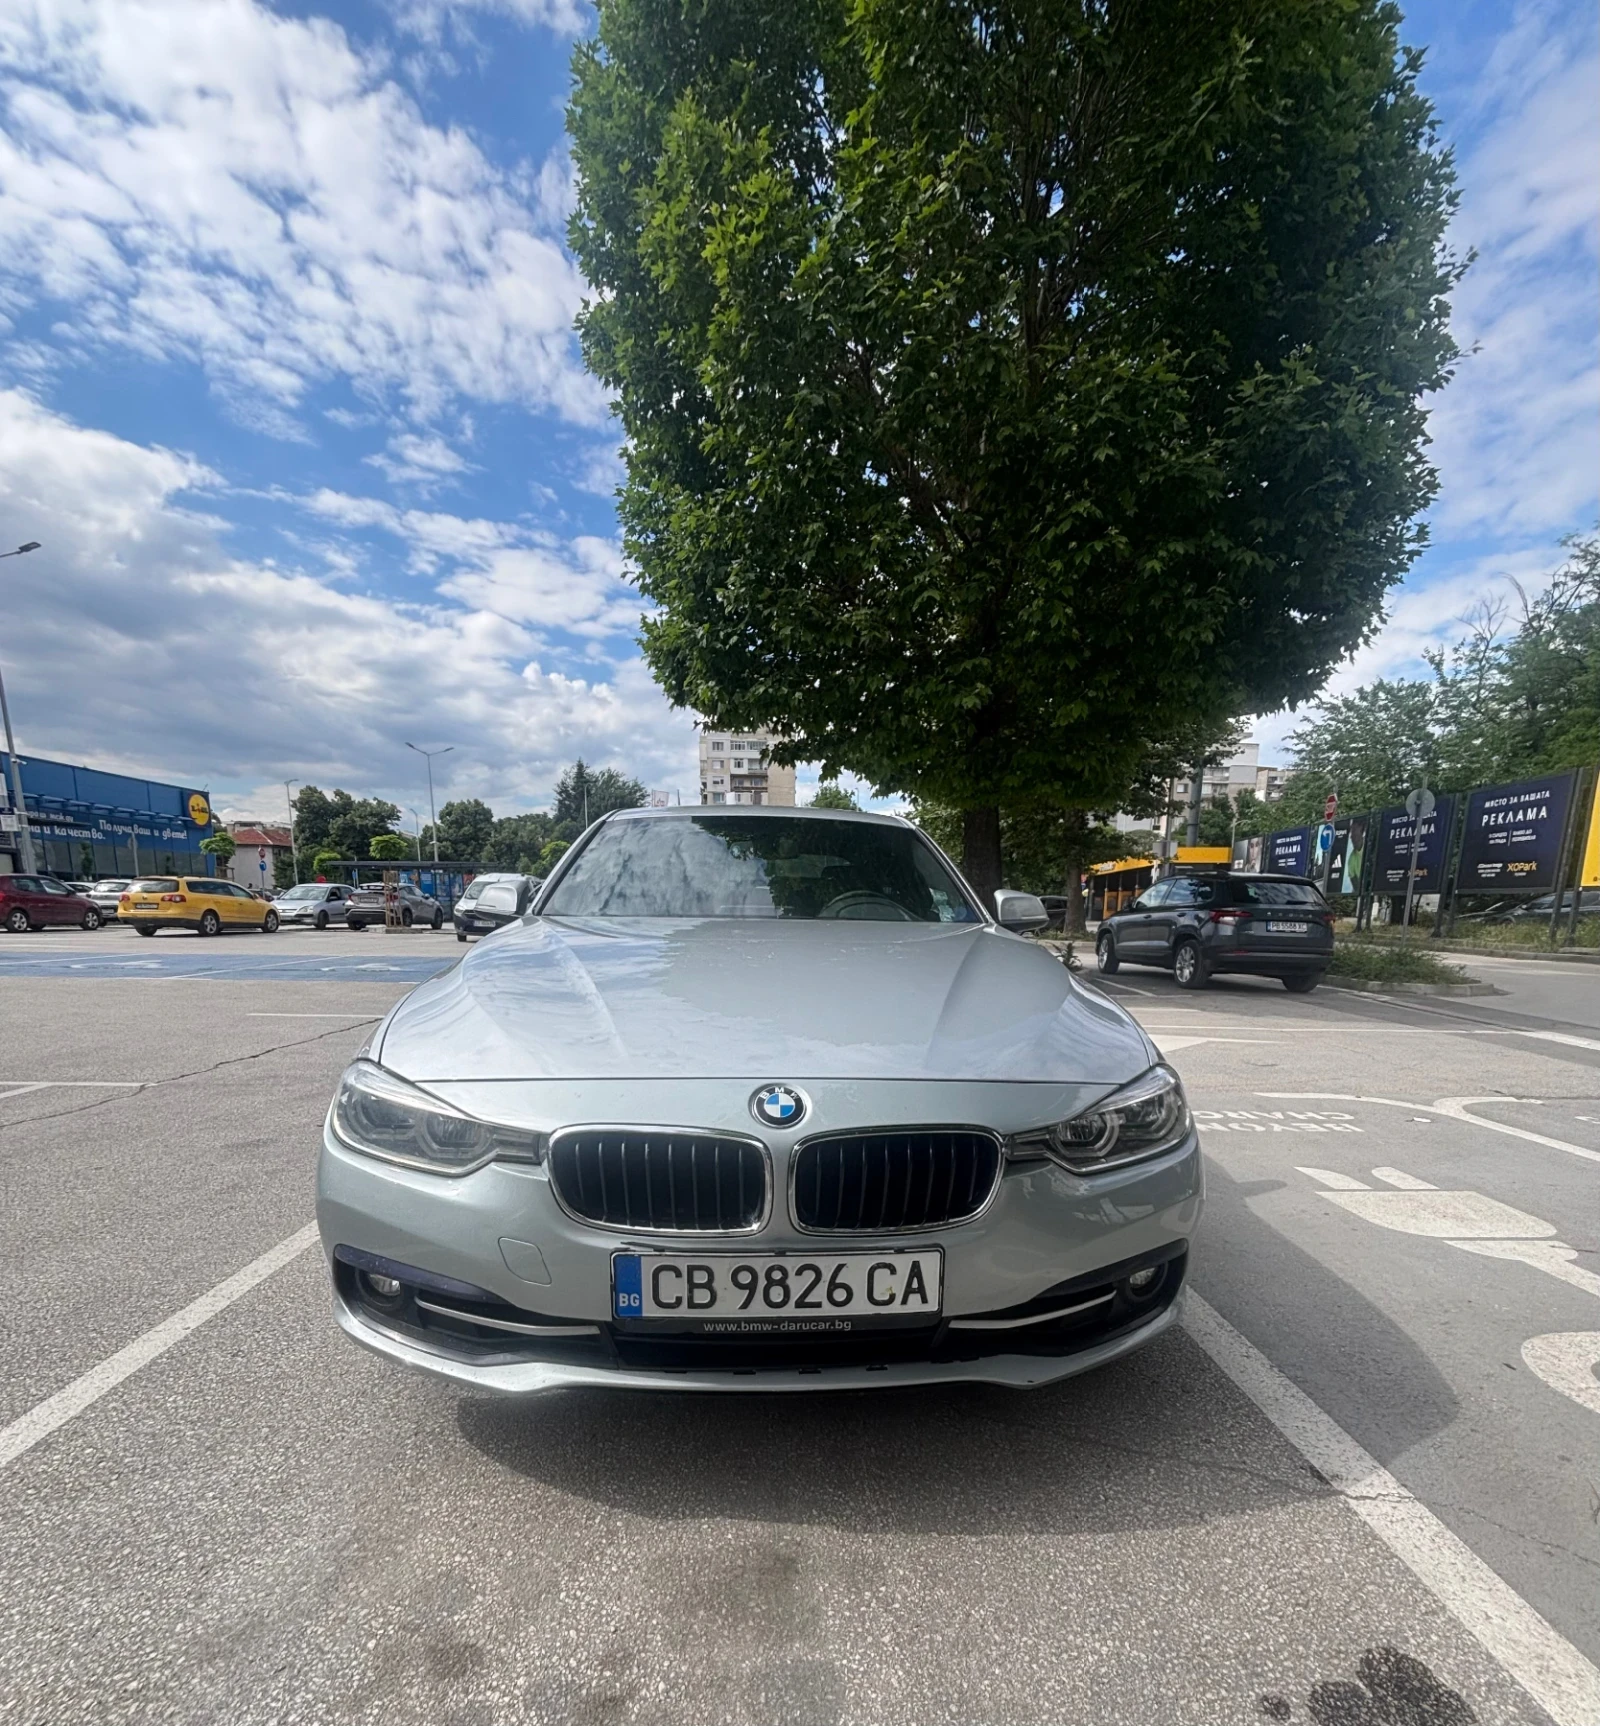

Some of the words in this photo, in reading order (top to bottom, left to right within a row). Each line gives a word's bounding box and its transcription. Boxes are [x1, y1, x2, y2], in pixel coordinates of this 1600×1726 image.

[1508, 796, 1518, 804] ЗА
[1520, 790, 1550, 802] ВАШАТА
[1481, 806, 1547, 827] РЕКЛАМА
[43, 825, 51, 835] и
[153, 829, 160, 837] и
[1506, 861, 1537, 872] XOPark
[760, 1086, 799, 1100] BMW
[652, 1264, 718, 1309] CB
[730, 1263, 854, 1310] 9826
[866, 1260, 929, 1307] CA
[619, 1293, 640, 1307] BG
[703, 1319, 852, 1331] www.bmw-darucar.bg
